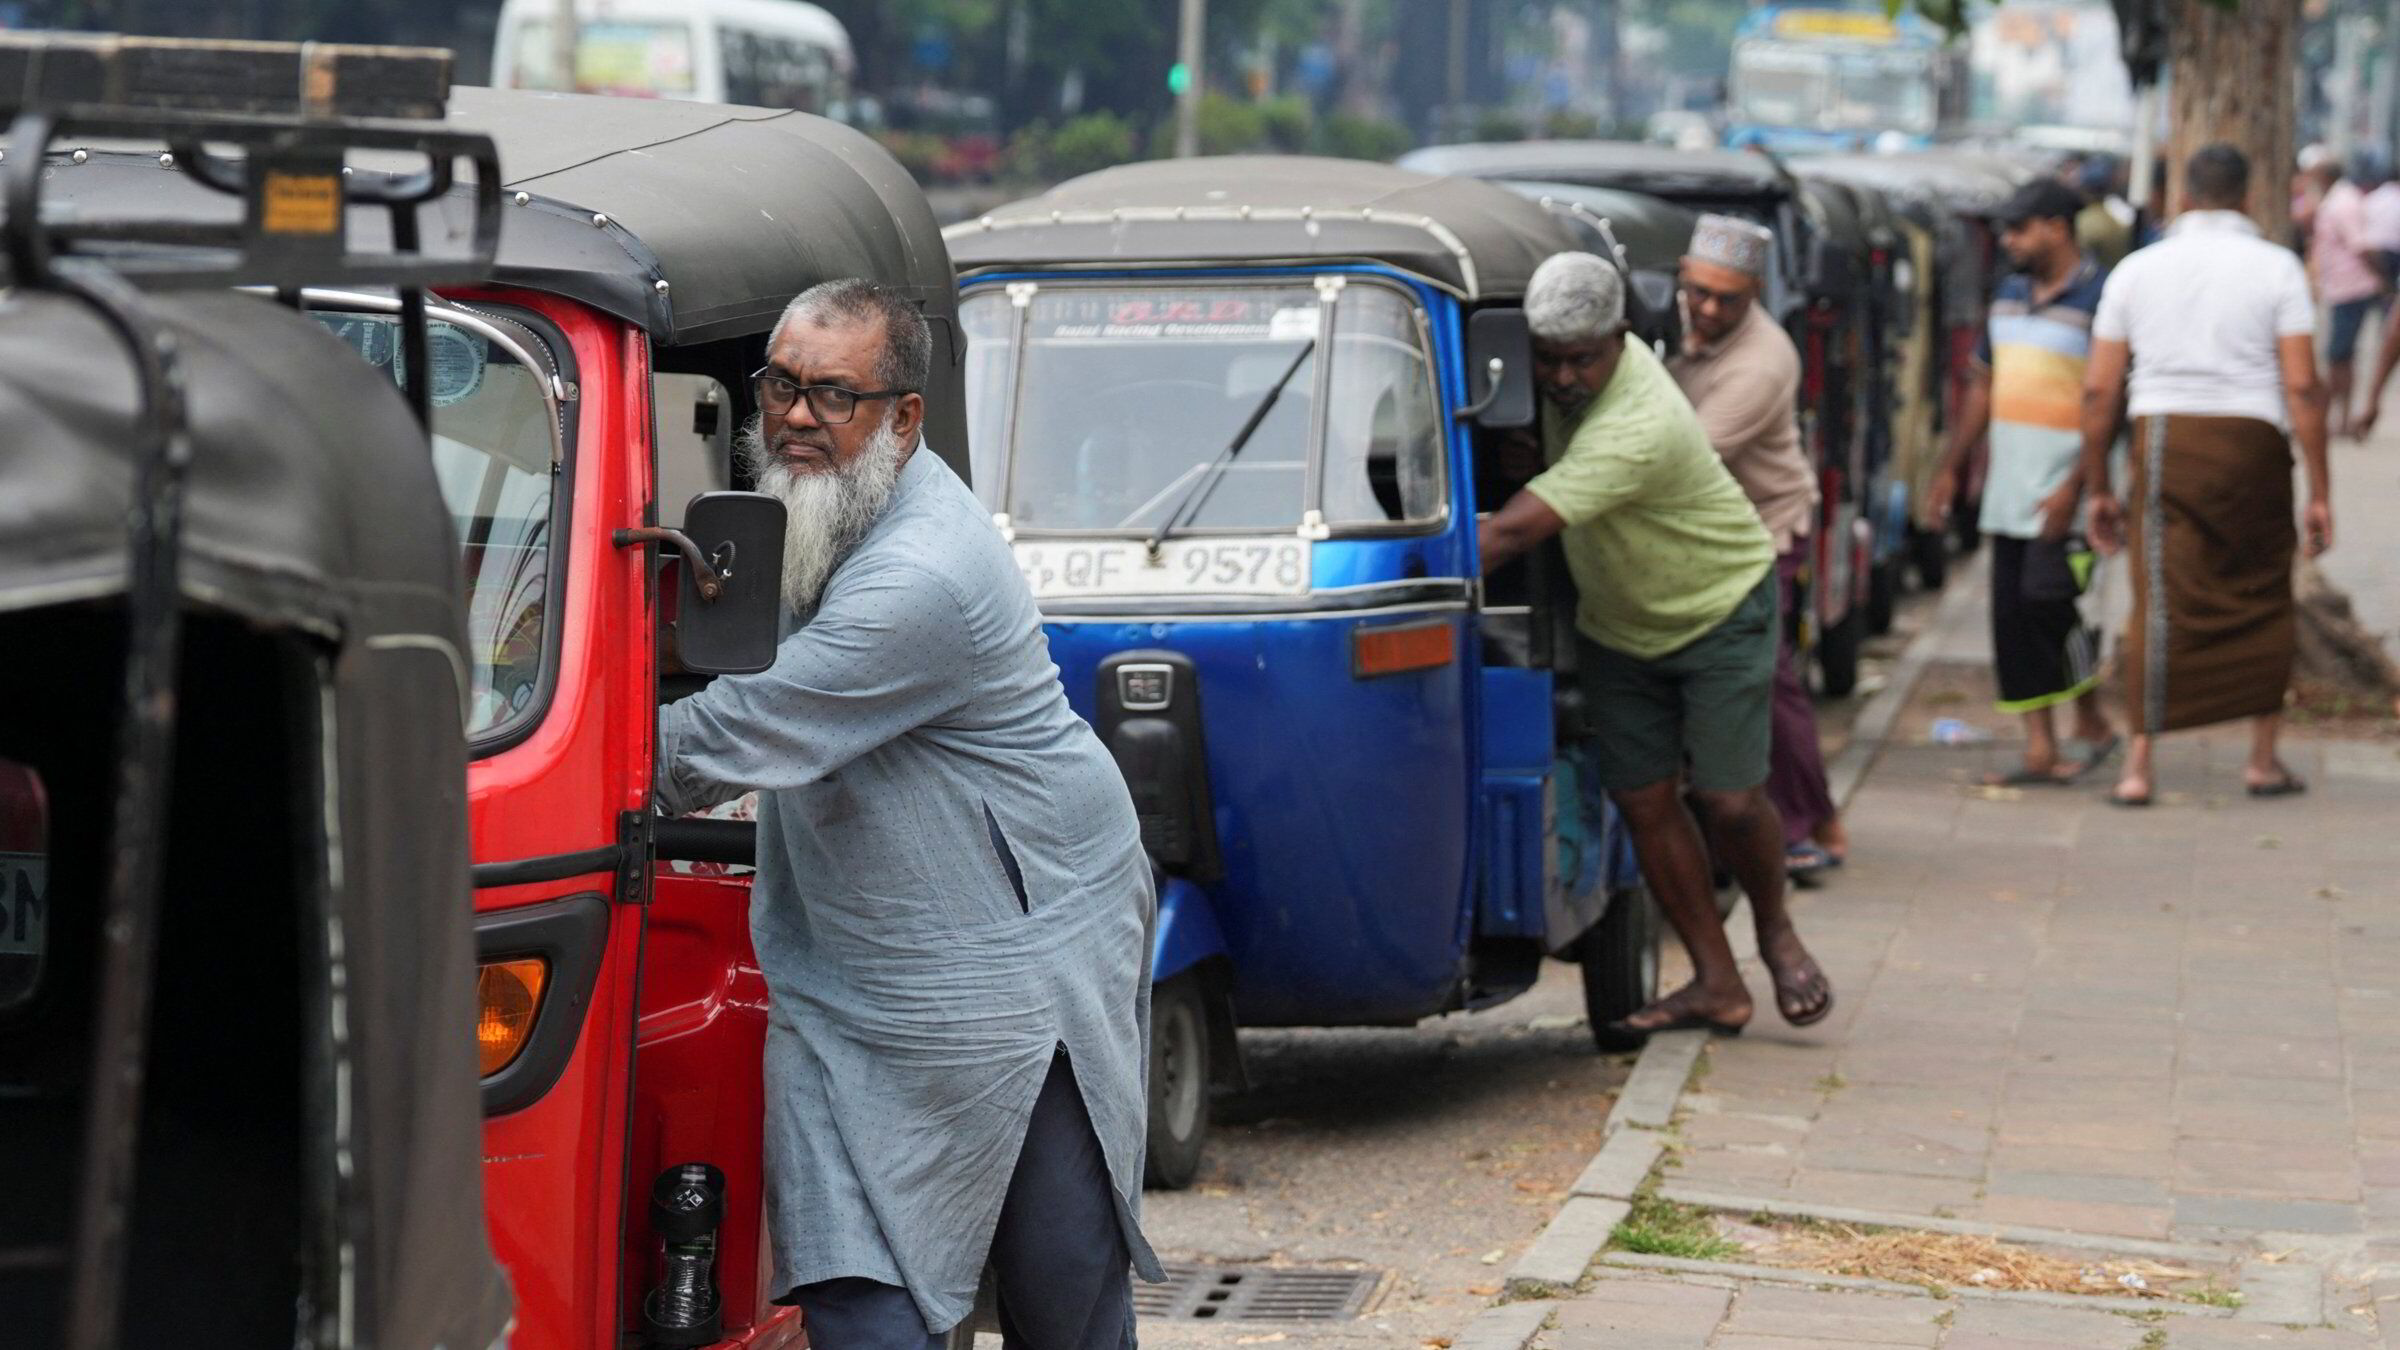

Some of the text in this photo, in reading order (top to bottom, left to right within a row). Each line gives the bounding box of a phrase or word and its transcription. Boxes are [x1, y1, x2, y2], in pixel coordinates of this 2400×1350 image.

[1102, 323, 1162, 338] Racing
[1063, 548, 1125, 588] QF
[1182, 544, 1302, 586] 9578
